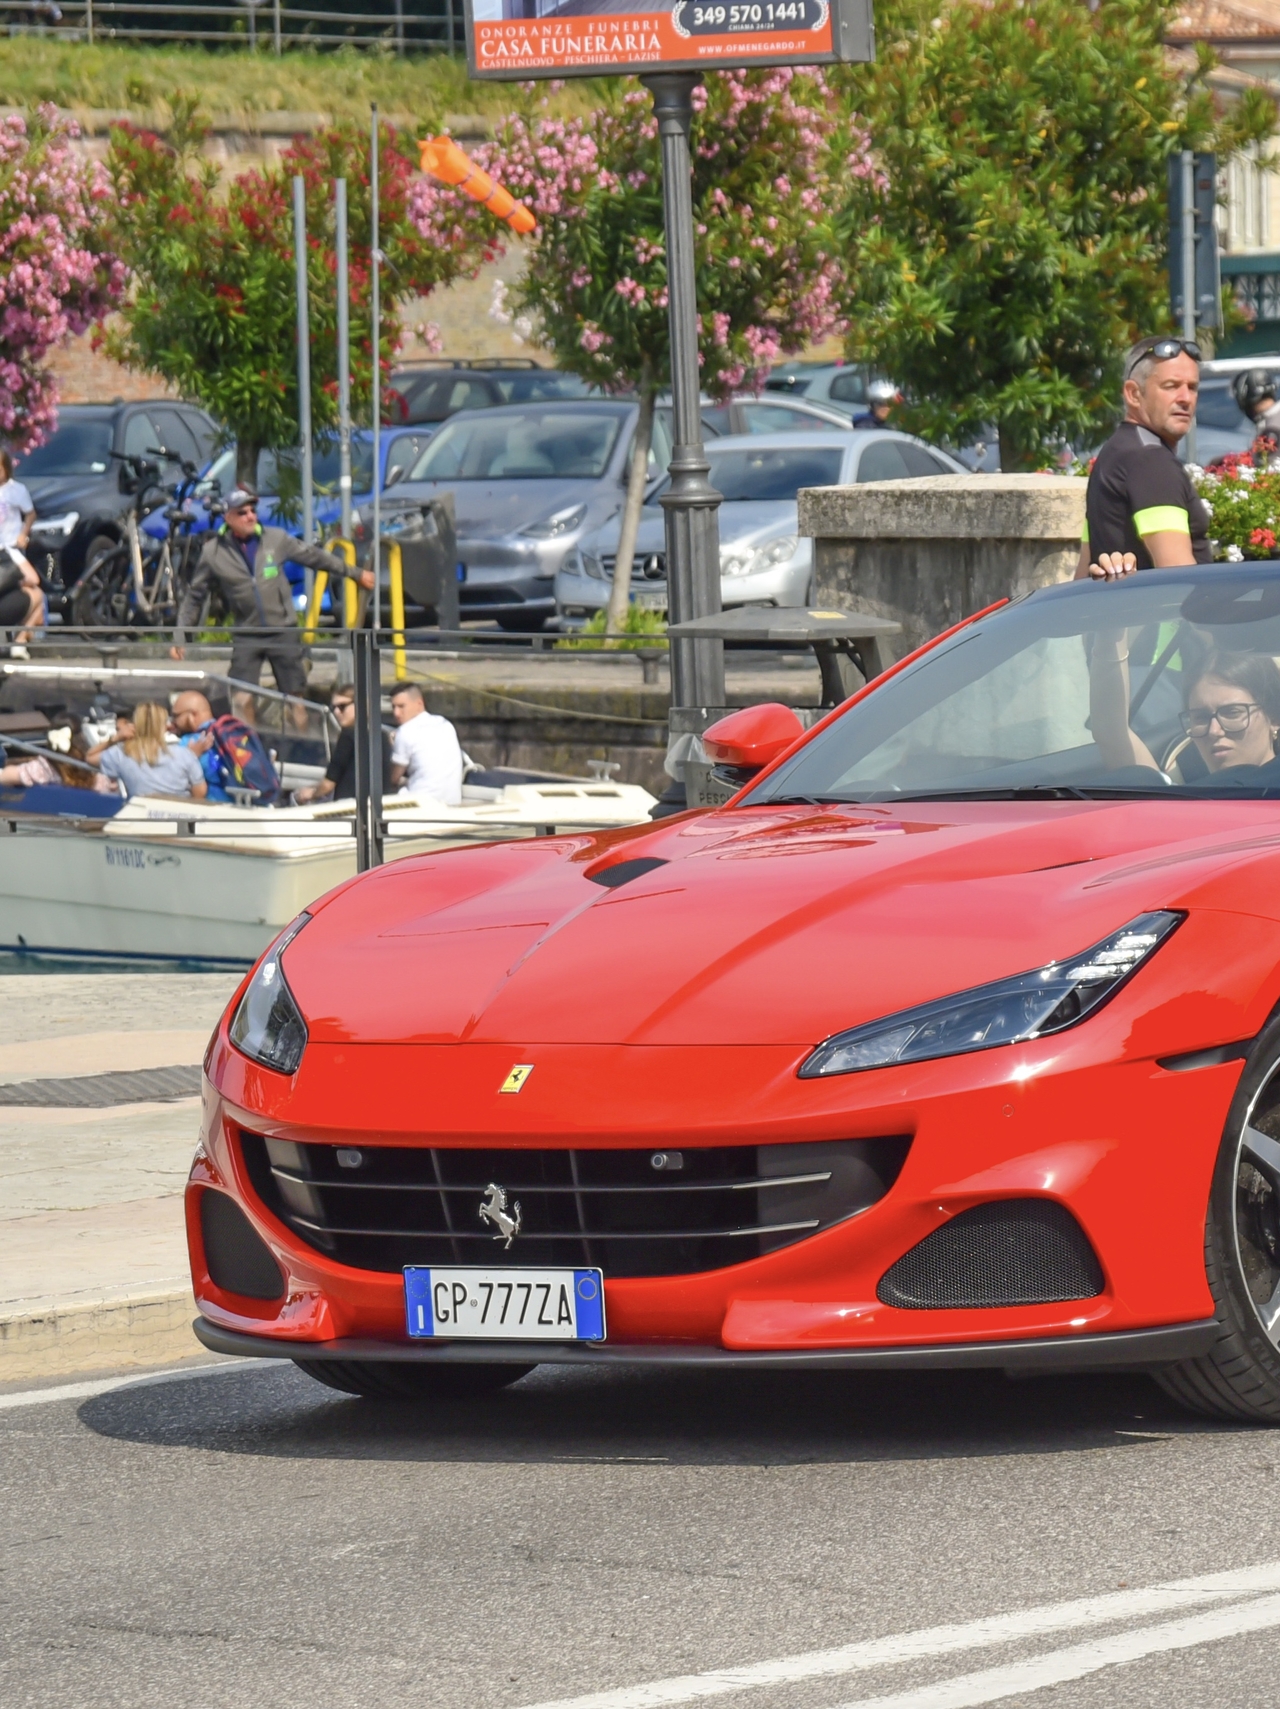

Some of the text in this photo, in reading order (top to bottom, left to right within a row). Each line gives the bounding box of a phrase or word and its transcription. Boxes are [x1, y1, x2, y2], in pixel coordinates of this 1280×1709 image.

[693, 2, 806, 26] 349 570 1441
[480, 20, 660, 39] ONORANZE FUNEBRI
[480, 33, 662, 58] CASA FUNERARIA
[698, 41, 806, 55] WWW.OFMENEGARDO.IT
[481, 56, 555, 69] CASTELNUOVO
[564, 53, 618, 65] PESCHIERA
[628, 51, 662, 62] LAZISE
